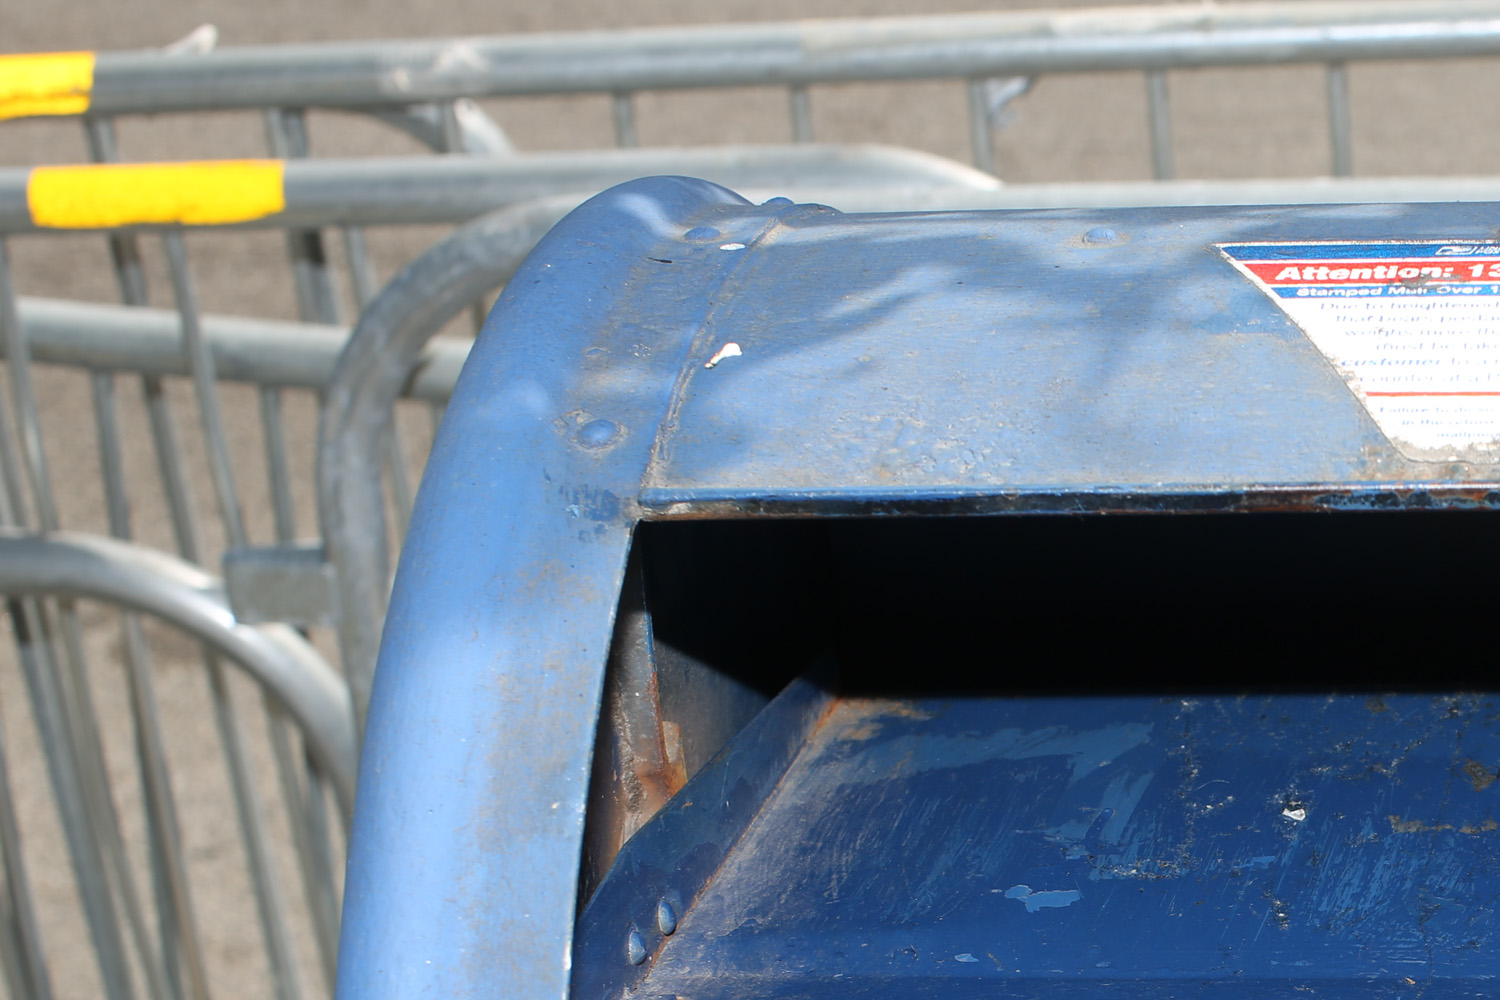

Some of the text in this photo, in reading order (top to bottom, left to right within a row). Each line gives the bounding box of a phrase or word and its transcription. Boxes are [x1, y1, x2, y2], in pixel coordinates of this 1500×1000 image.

[1276, 266, 1454, 280] Attention:
[1297, 286, 1382, 298] Stamped
[1436, 285, 1482, 295] Over
[1341, 358, 1441, 367] customer
